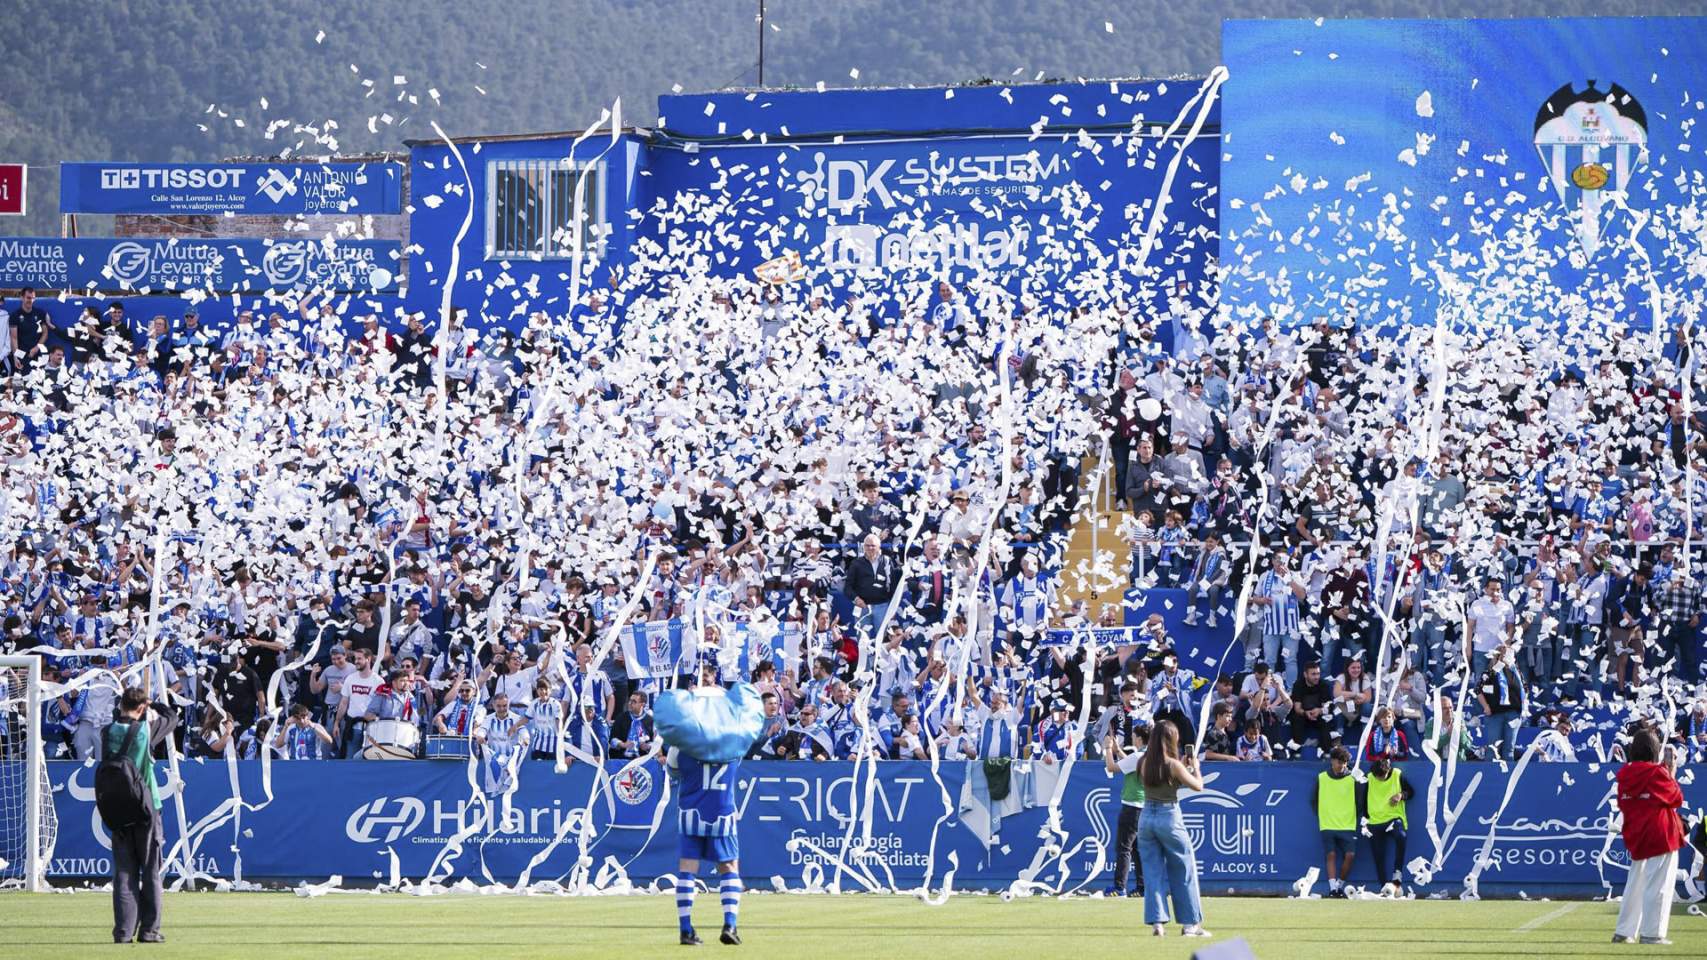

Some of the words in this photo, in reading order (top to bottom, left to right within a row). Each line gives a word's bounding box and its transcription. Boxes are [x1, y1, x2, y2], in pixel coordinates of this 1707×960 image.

[142, 169, 246, 188] TISSOT
[828, 159, 897, 209] DK
[899, 154, 1060, 185] SYSTEM
[228, 194, 246, 203] Alcoy
[914, 187, 963, 197] STEMAS
[984, 185, 1044, 195] SEURIDD
[305, 199, 341, 211] joyeros
[0, 241, 64, 258] Mutua
[154, 242, 218, 260] Mutua
[151, 259, 223, 274] Levante
[0, 274, 67, 282] EGUROS
[1082, 634, 1127, 643] ACOYAN
[702, 764, 728, 791] 12
[513, 836, 551, 844] saludable
[791, 832, 902, 853] Implantoogía
[1473, 849, 1600, 866] asesores
[1212, 863, 1256, 875] ALCOY,
